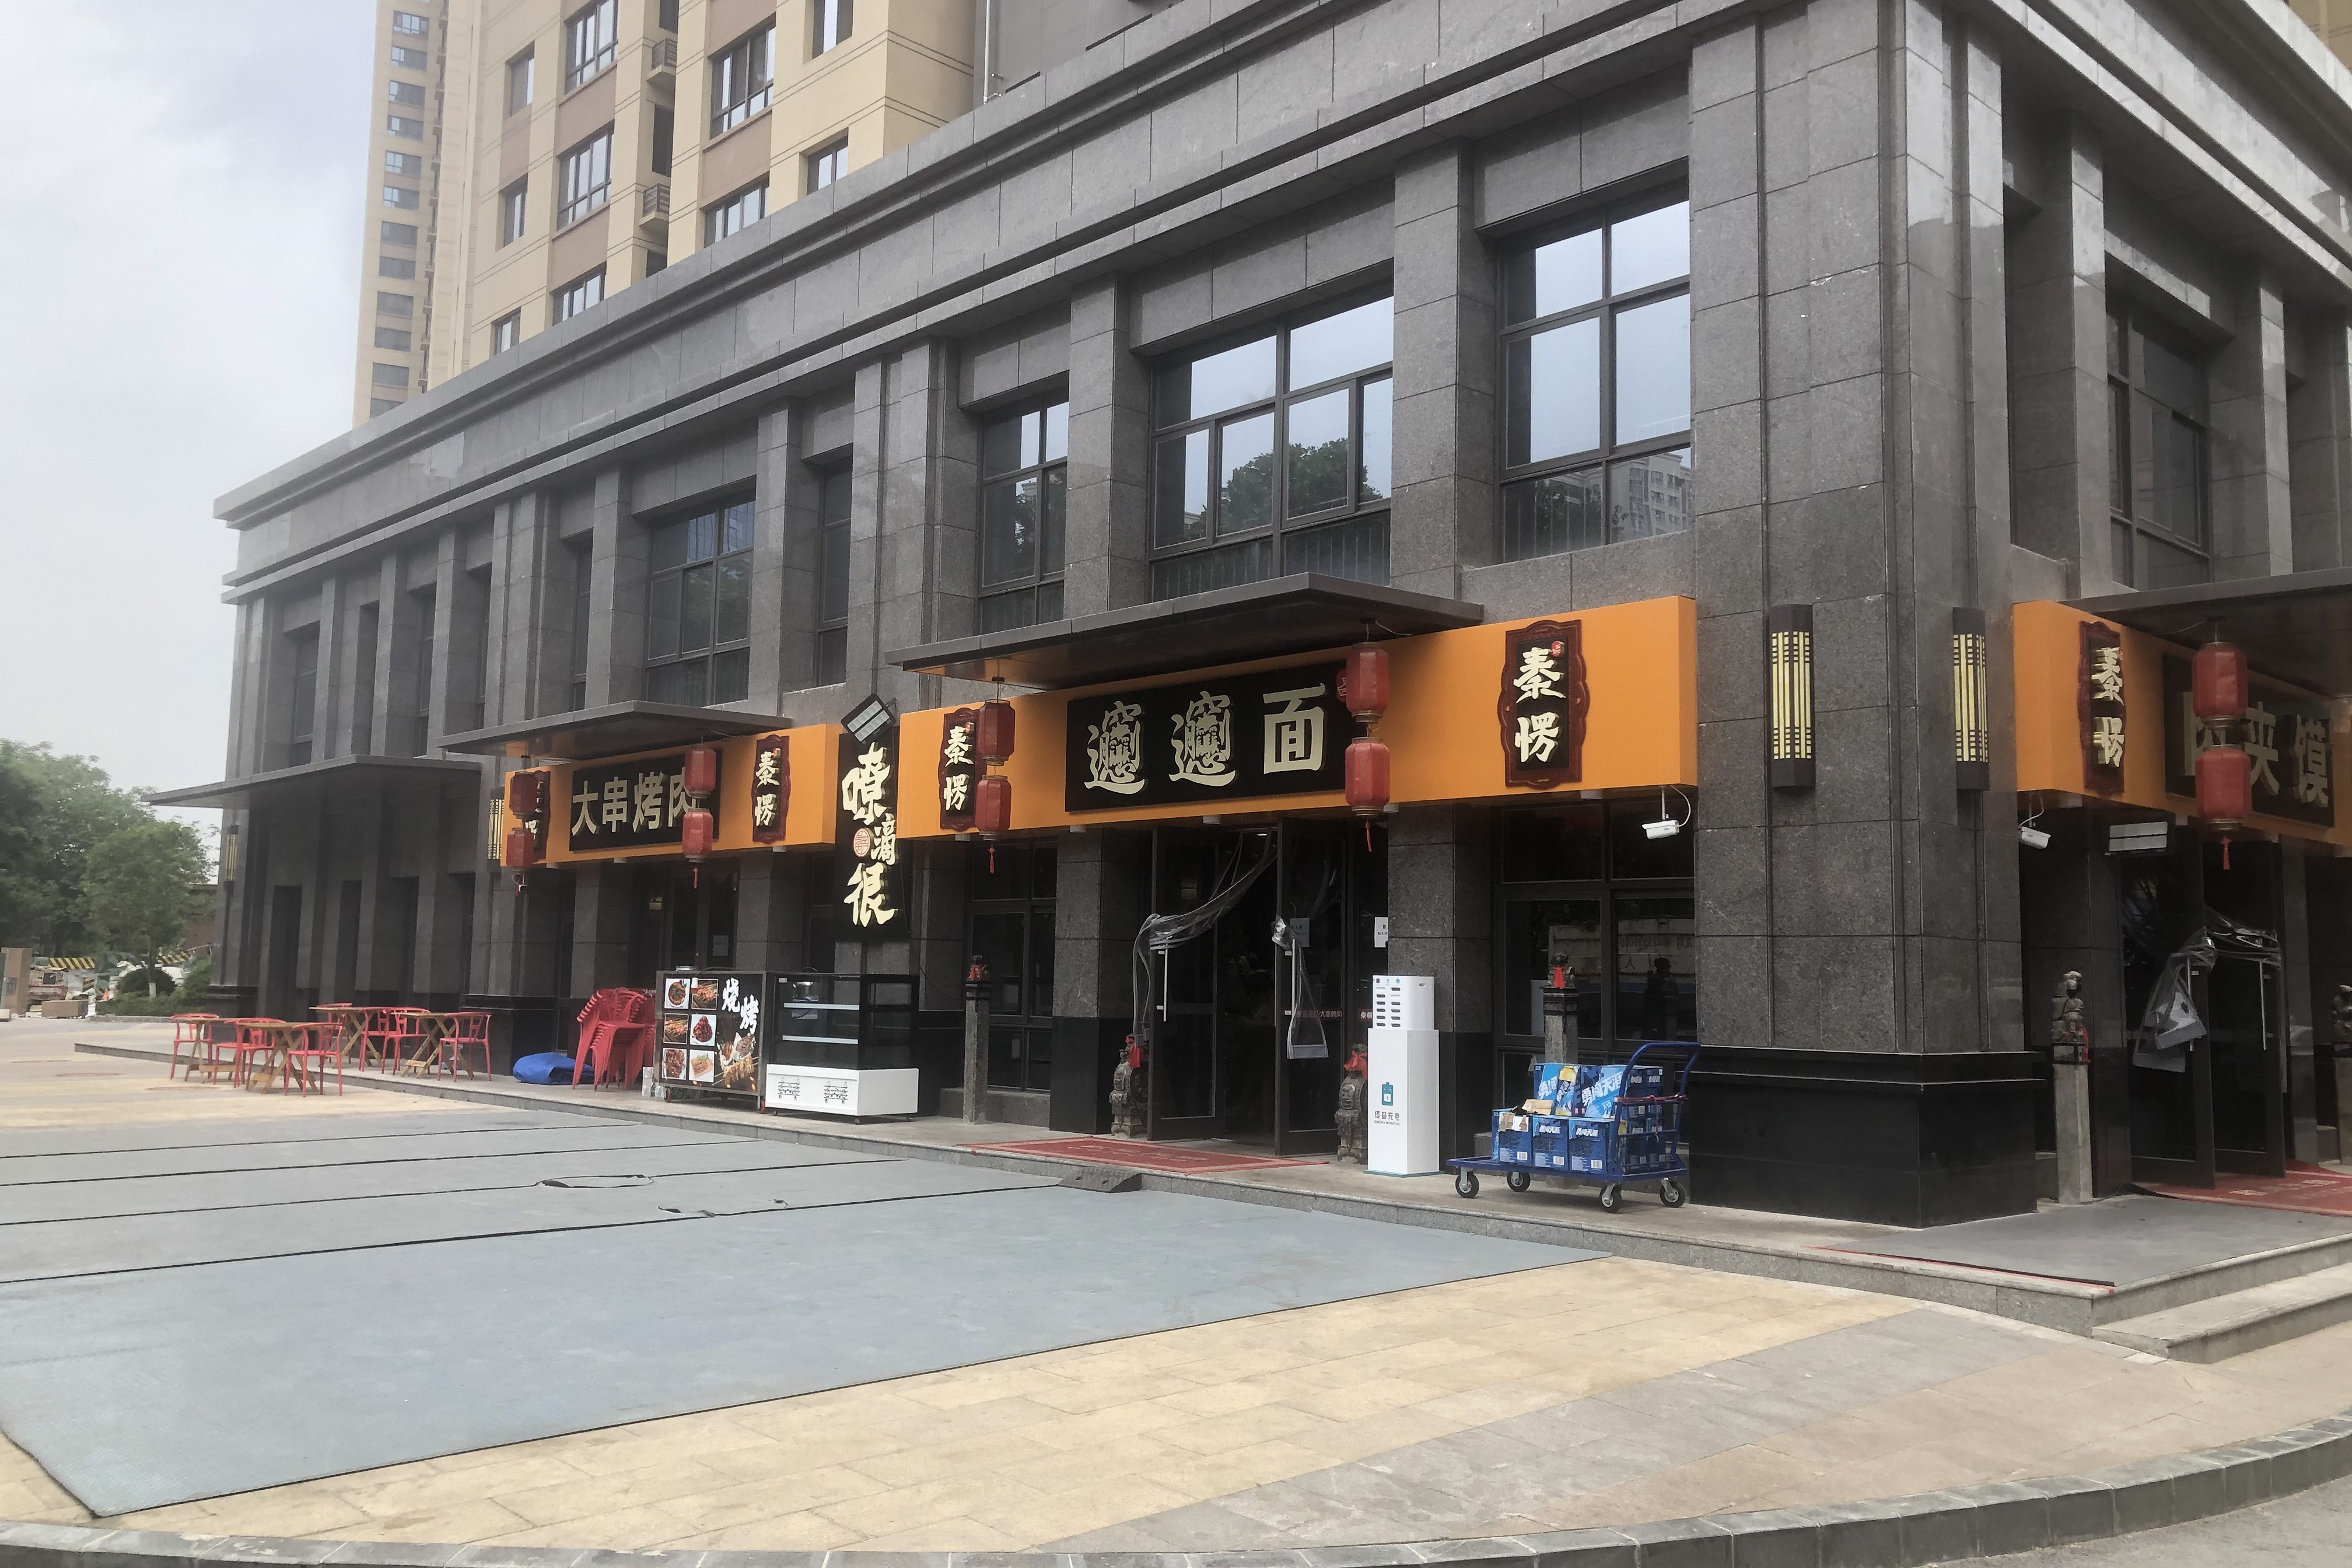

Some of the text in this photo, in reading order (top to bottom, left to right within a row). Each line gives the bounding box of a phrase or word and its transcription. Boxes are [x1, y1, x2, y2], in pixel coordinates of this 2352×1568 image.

[1513, 647, 1566, 762] 秦愣
[754, 751, 780, 827] 秦愣
[943, 726, 975, 811] 秦愣
[722, 977, 759, 1034] 烧烤
[1374, 1111, 1400, 1121] 怪兽充电
[1581, 1071, 1623, 1107] 勇闯天涯
